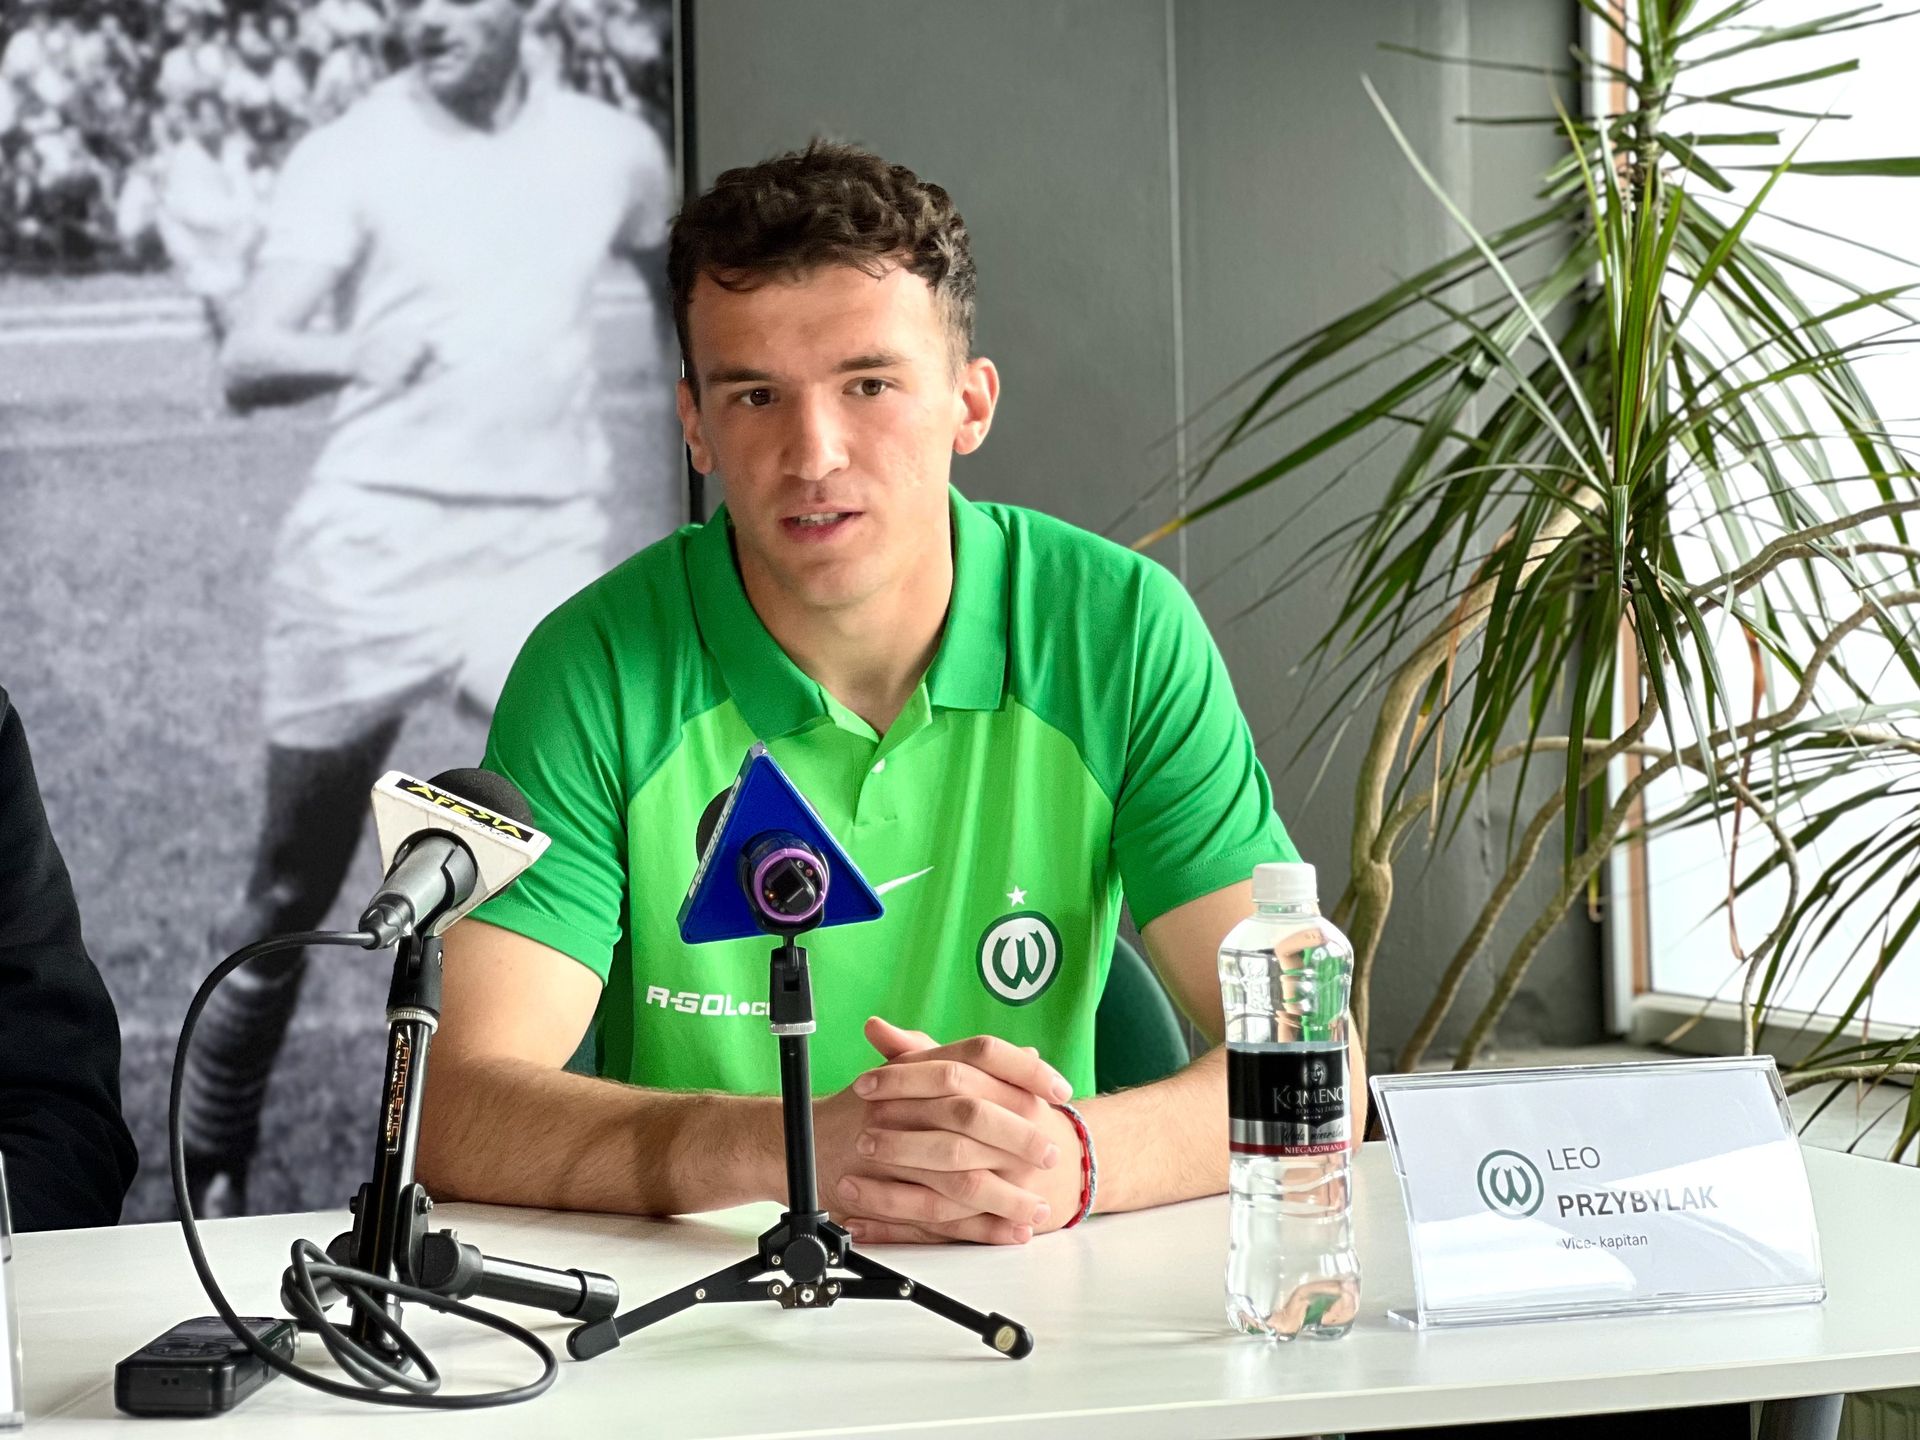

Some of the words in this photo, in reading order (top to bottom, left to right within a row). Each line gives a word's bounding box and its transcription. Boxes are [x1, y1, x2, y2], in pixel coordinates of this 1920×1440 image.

[1285, 1144, 1343, 1154] NIEGAZOWANA
[1547, 1146, 1601, 1171] LEO
[1557, 1185, 1718, 1218] PRZYBYLAK
[1561, 1236, 1597, 1250] Vice-
[1599, 1232, 1649, 1251] kapitan
